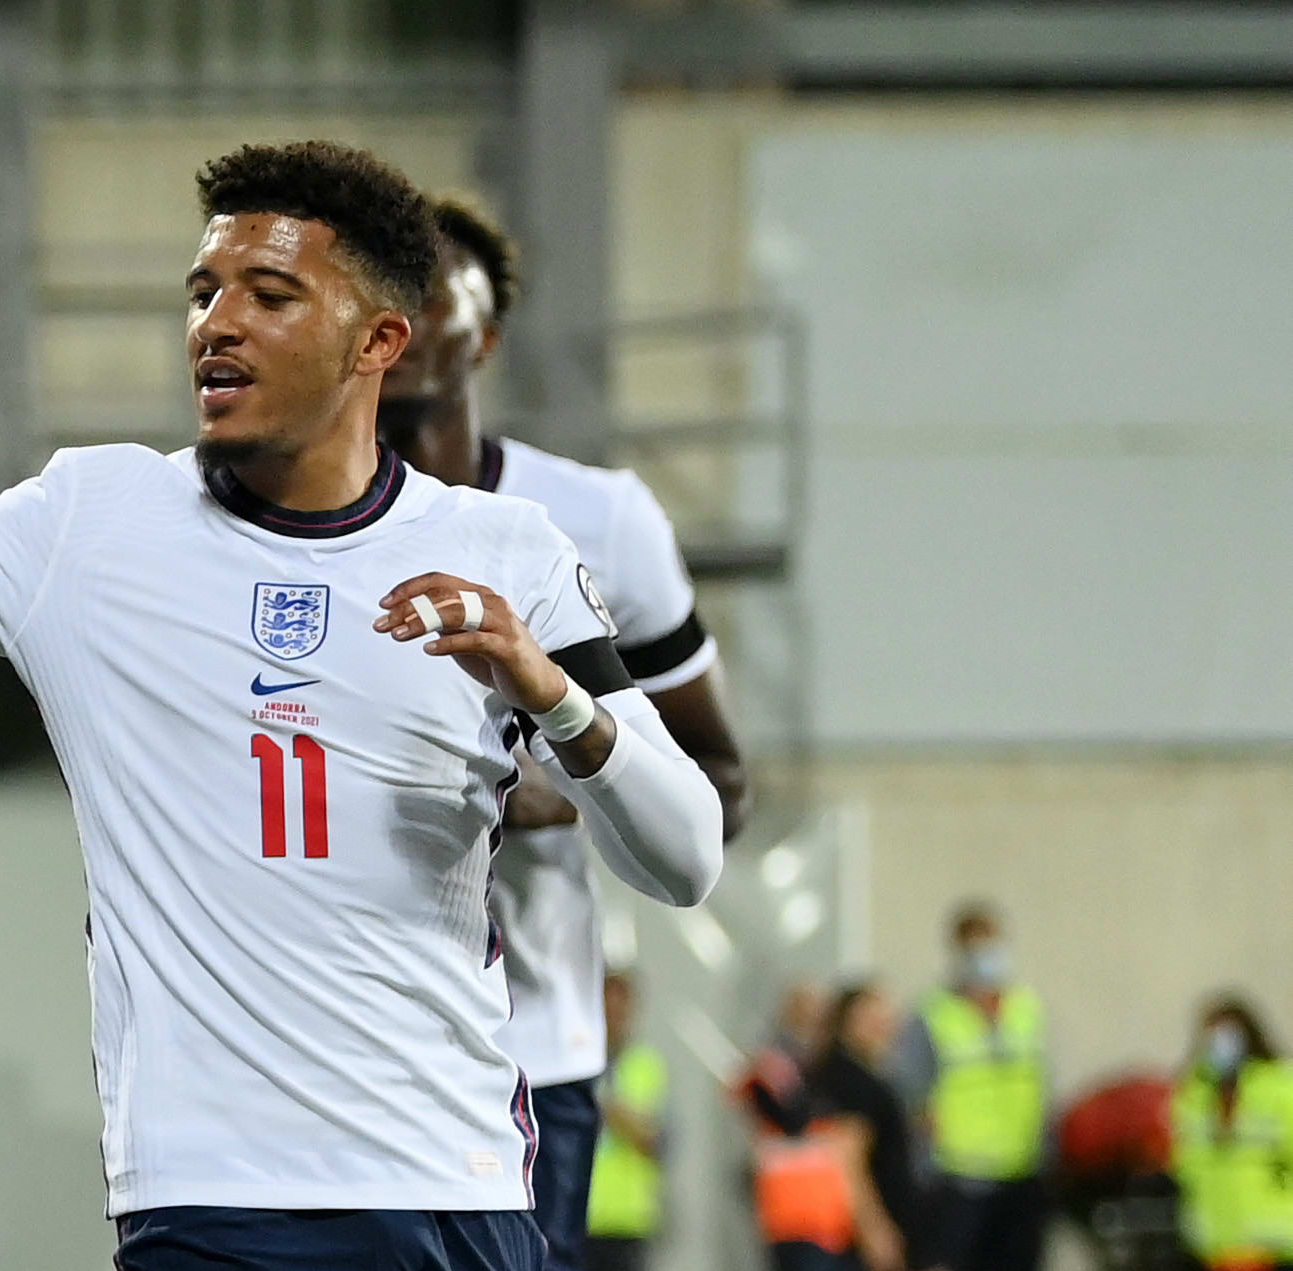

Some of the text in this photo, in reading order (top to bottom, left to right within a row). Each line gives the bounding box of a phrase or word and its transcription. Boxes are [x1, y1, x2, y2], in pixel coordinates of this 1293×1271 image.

[264, 702, 307, 713] ANDORRA
[259, 711, 298, 723] OCTOBER
[251, 734, 328, 858] 11
